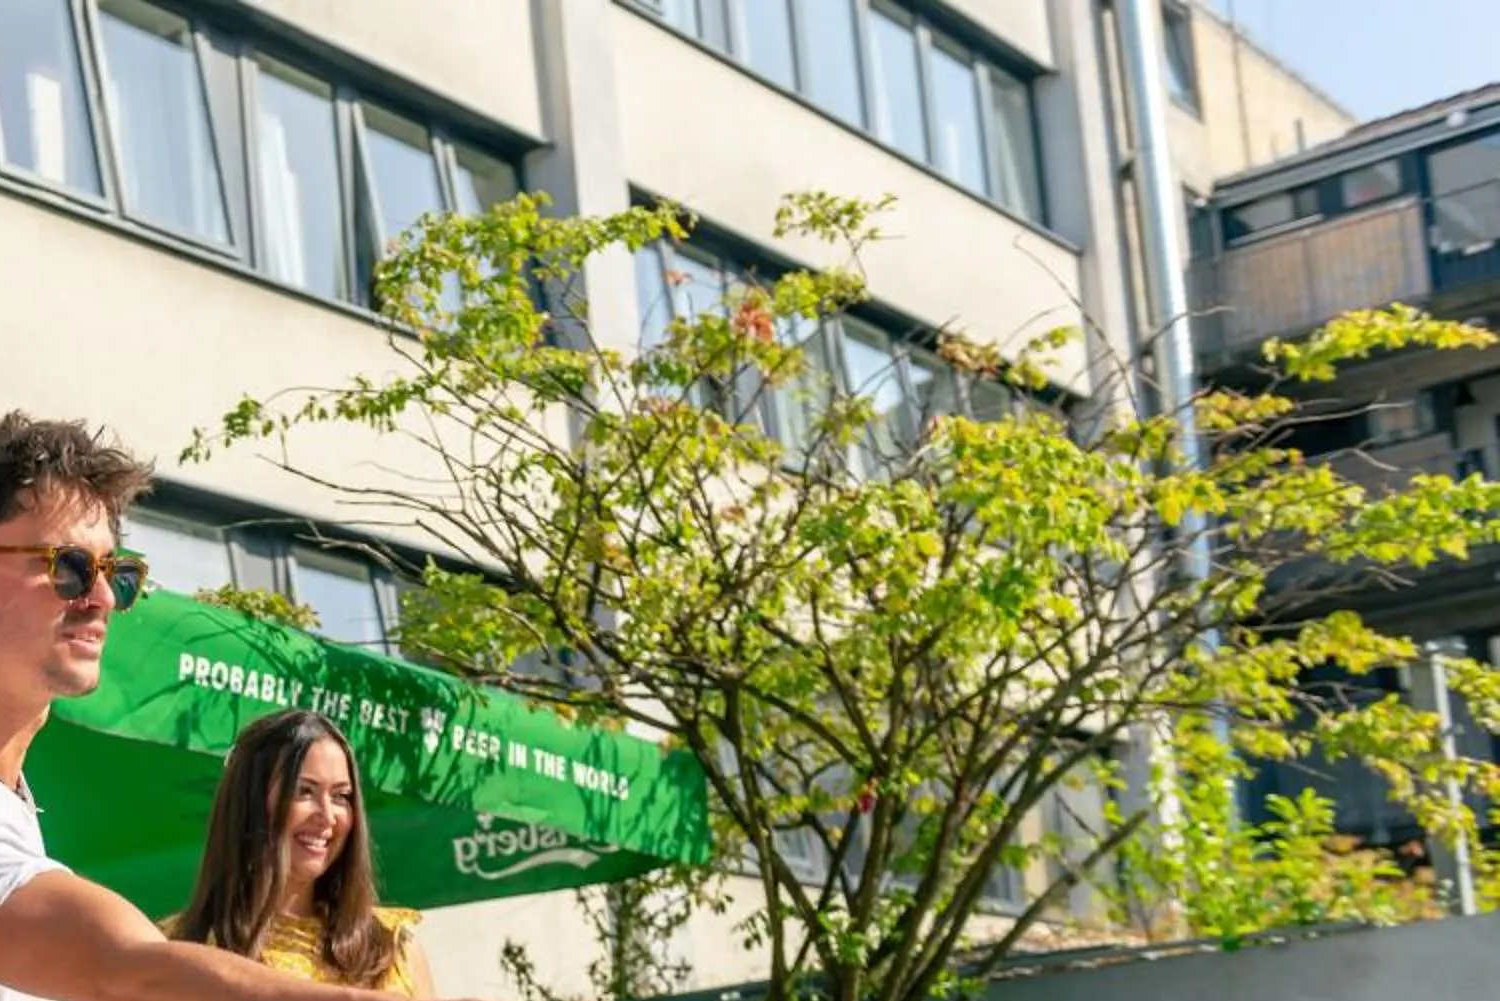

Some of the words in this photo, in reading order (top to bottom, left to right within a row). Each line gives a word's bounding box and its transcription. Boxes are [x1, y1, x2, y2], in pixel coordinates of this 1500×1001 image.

[179, 653, 303, 707] PROBABLY
[311, 686, 352, 720] THE
[359, 698, 411, 735] BEST
[452, 724, 501, 762] BEER
[508, 740, 527, 769] IN
[533, 748, 567, 782] THE
[572, 760, 630, 801] WORLD
